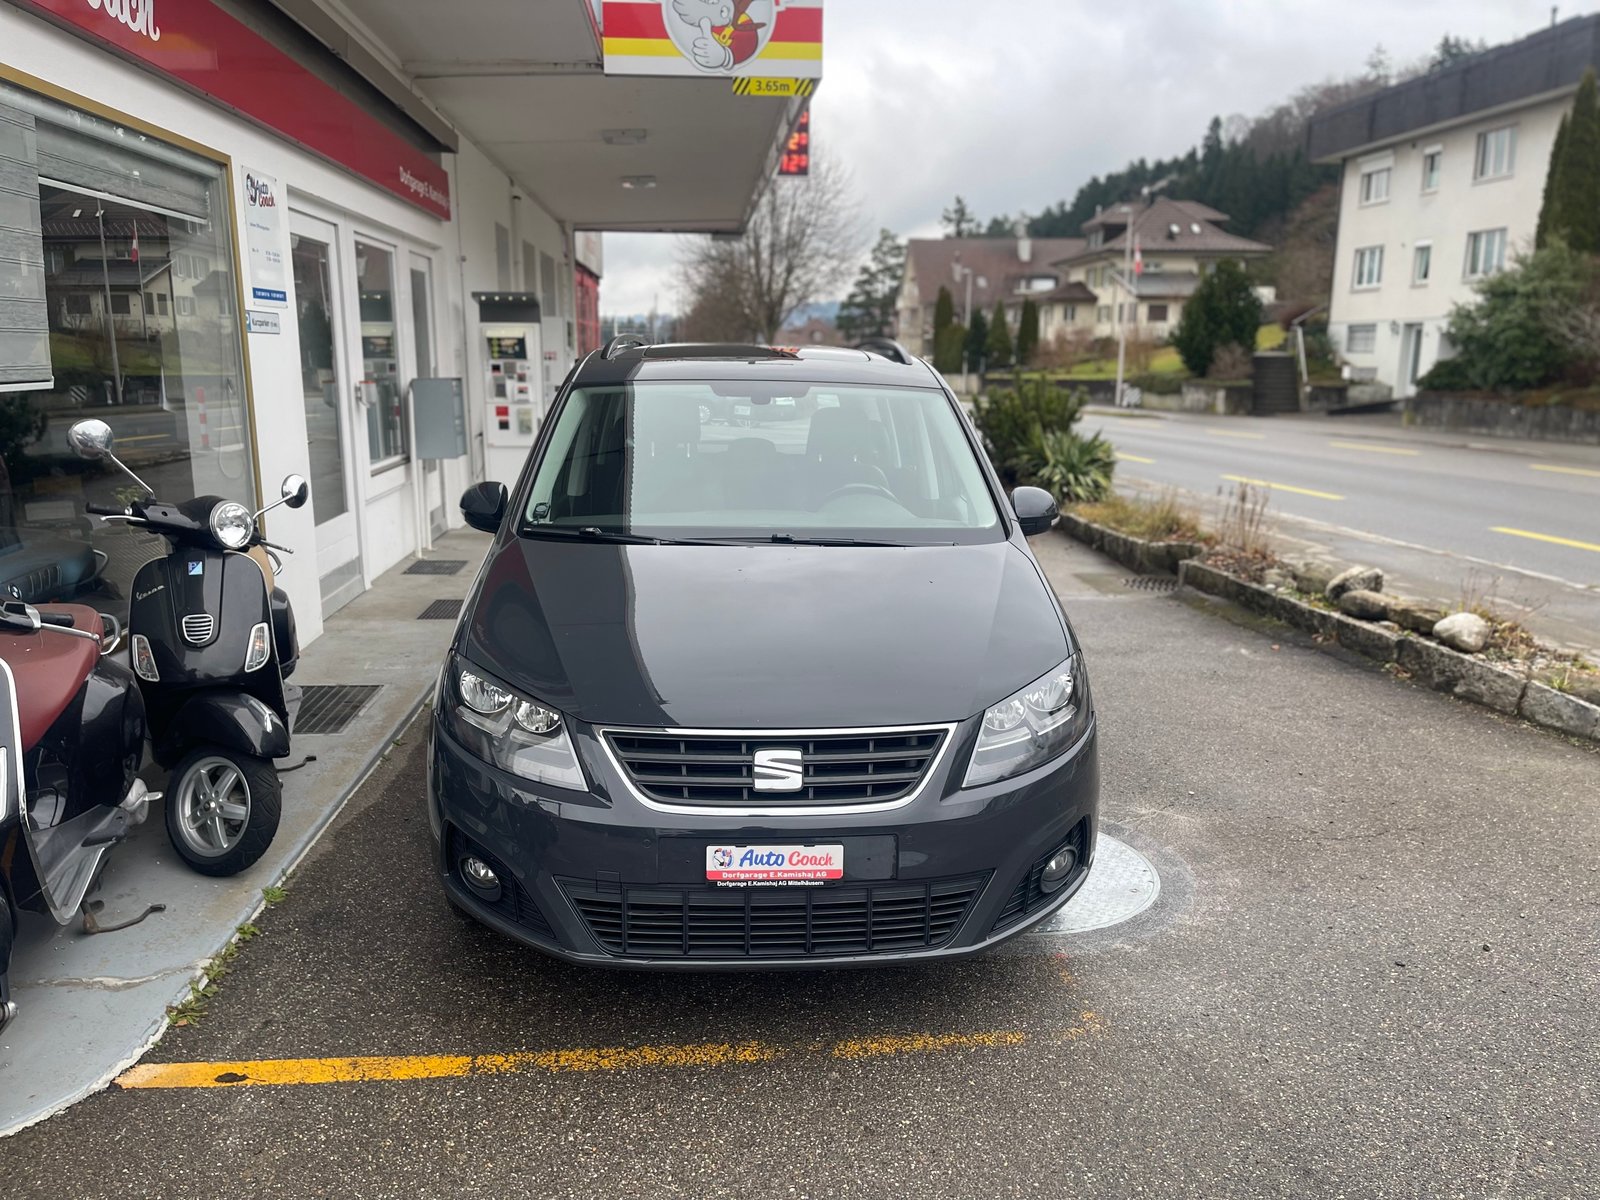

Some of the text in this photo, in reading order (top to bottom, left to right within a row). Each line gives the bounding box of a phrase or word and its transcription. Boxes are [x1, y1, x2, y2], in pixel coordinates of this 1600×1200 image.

[755, 80, 790, 93] 3.65m
[739, 849, 833, 867] Auto Coach
